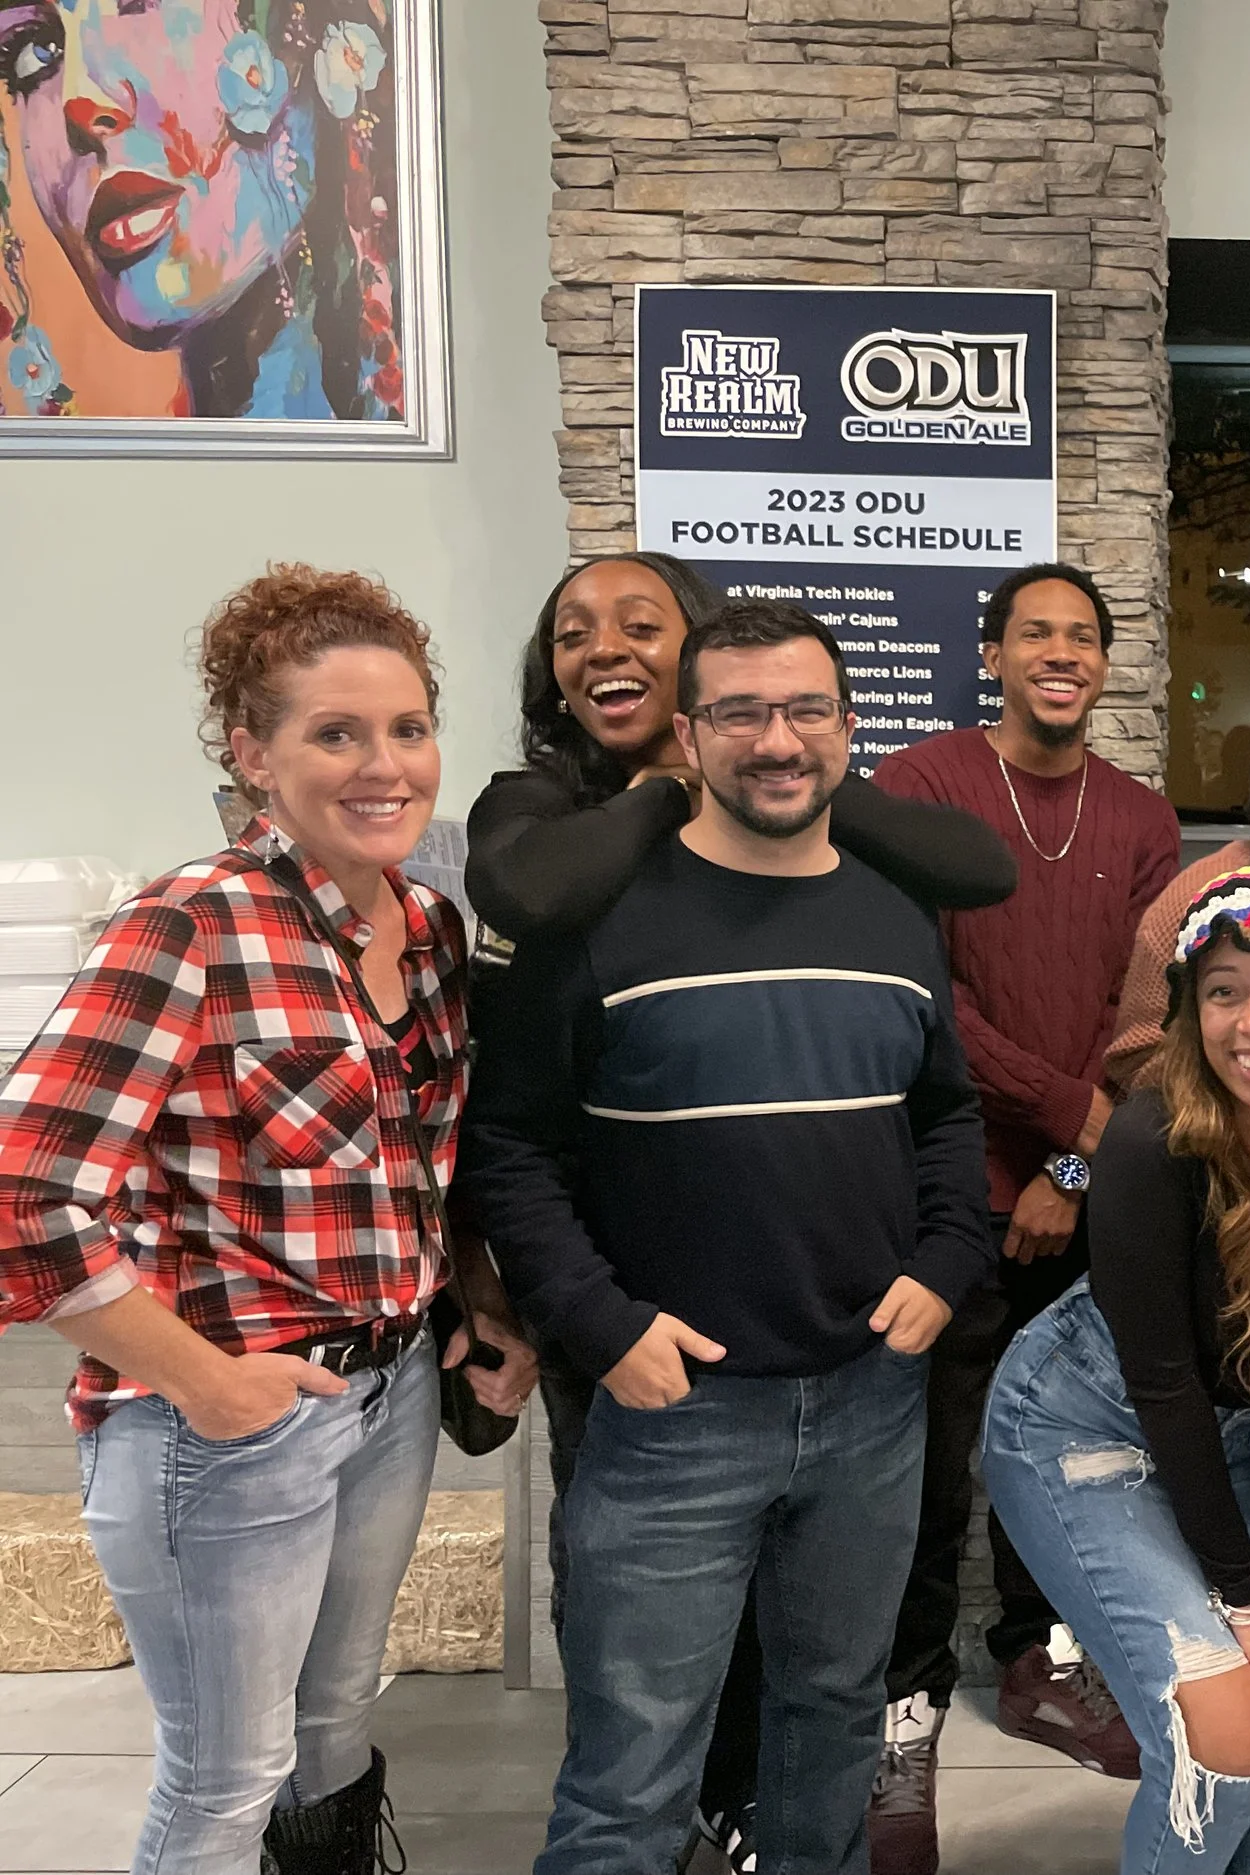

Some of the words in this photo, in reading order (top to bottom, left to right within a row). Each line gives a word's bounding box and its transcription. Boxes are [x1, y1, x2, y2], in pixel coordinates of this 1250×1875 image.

[689, 337, 772, 376] NEW
[851, 342, 1016, 410] ODU
[668, 374, 794, 415] REALM
[667, 417, 729, 430] BREWING
[733, 418, 797, 431] COMPANY
[846, 420, 966, 440] GOLDEN
[971, 422, 1027, 441] ALE
[767, 488, 846, 514] 2023
[855, 490, 925, 515] ODU
[671, 520, 844, 547] FOOTBALL
[853, 524, 1022, 552] SCHEDULE
[726, 585, 743, 598] at
[745, 584, 803, 600] Virginia
[805, 586, 842, 600] Tech
[844, 587, 895, 602] Hokies
[849, 612, 899, 628] Cajuns
[836, 640, 876, 654] emon
[878, 640, 941, 655] Deacons
[845, 667, 890, 680] merce
[892, 665, 933, 680] Lions
[850, 690, 894, 706] dering
[897, 692, 933, 706] Herd
[855, 716, 903, 730] Golden
[906, 717, 954, 733] Eagles
